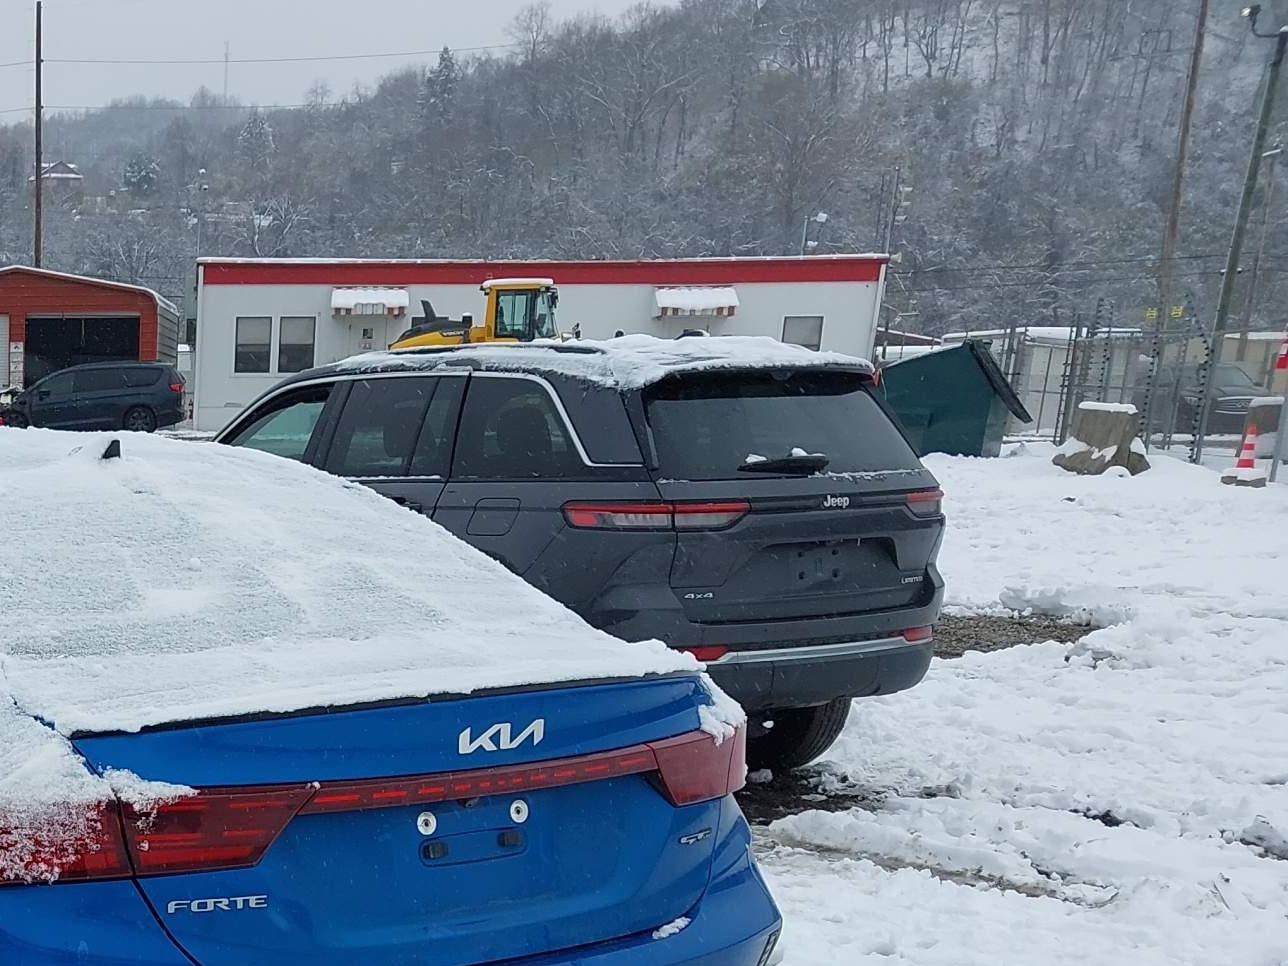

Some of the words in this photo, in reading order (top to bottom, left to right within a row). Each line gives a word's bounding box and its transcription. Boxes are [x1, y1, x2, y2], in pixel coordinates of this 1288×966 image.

[823, 494, 850, 509] Jeep
[458, 718, 545, 754] KIA
[167, 895, 268, 914] FORTE
